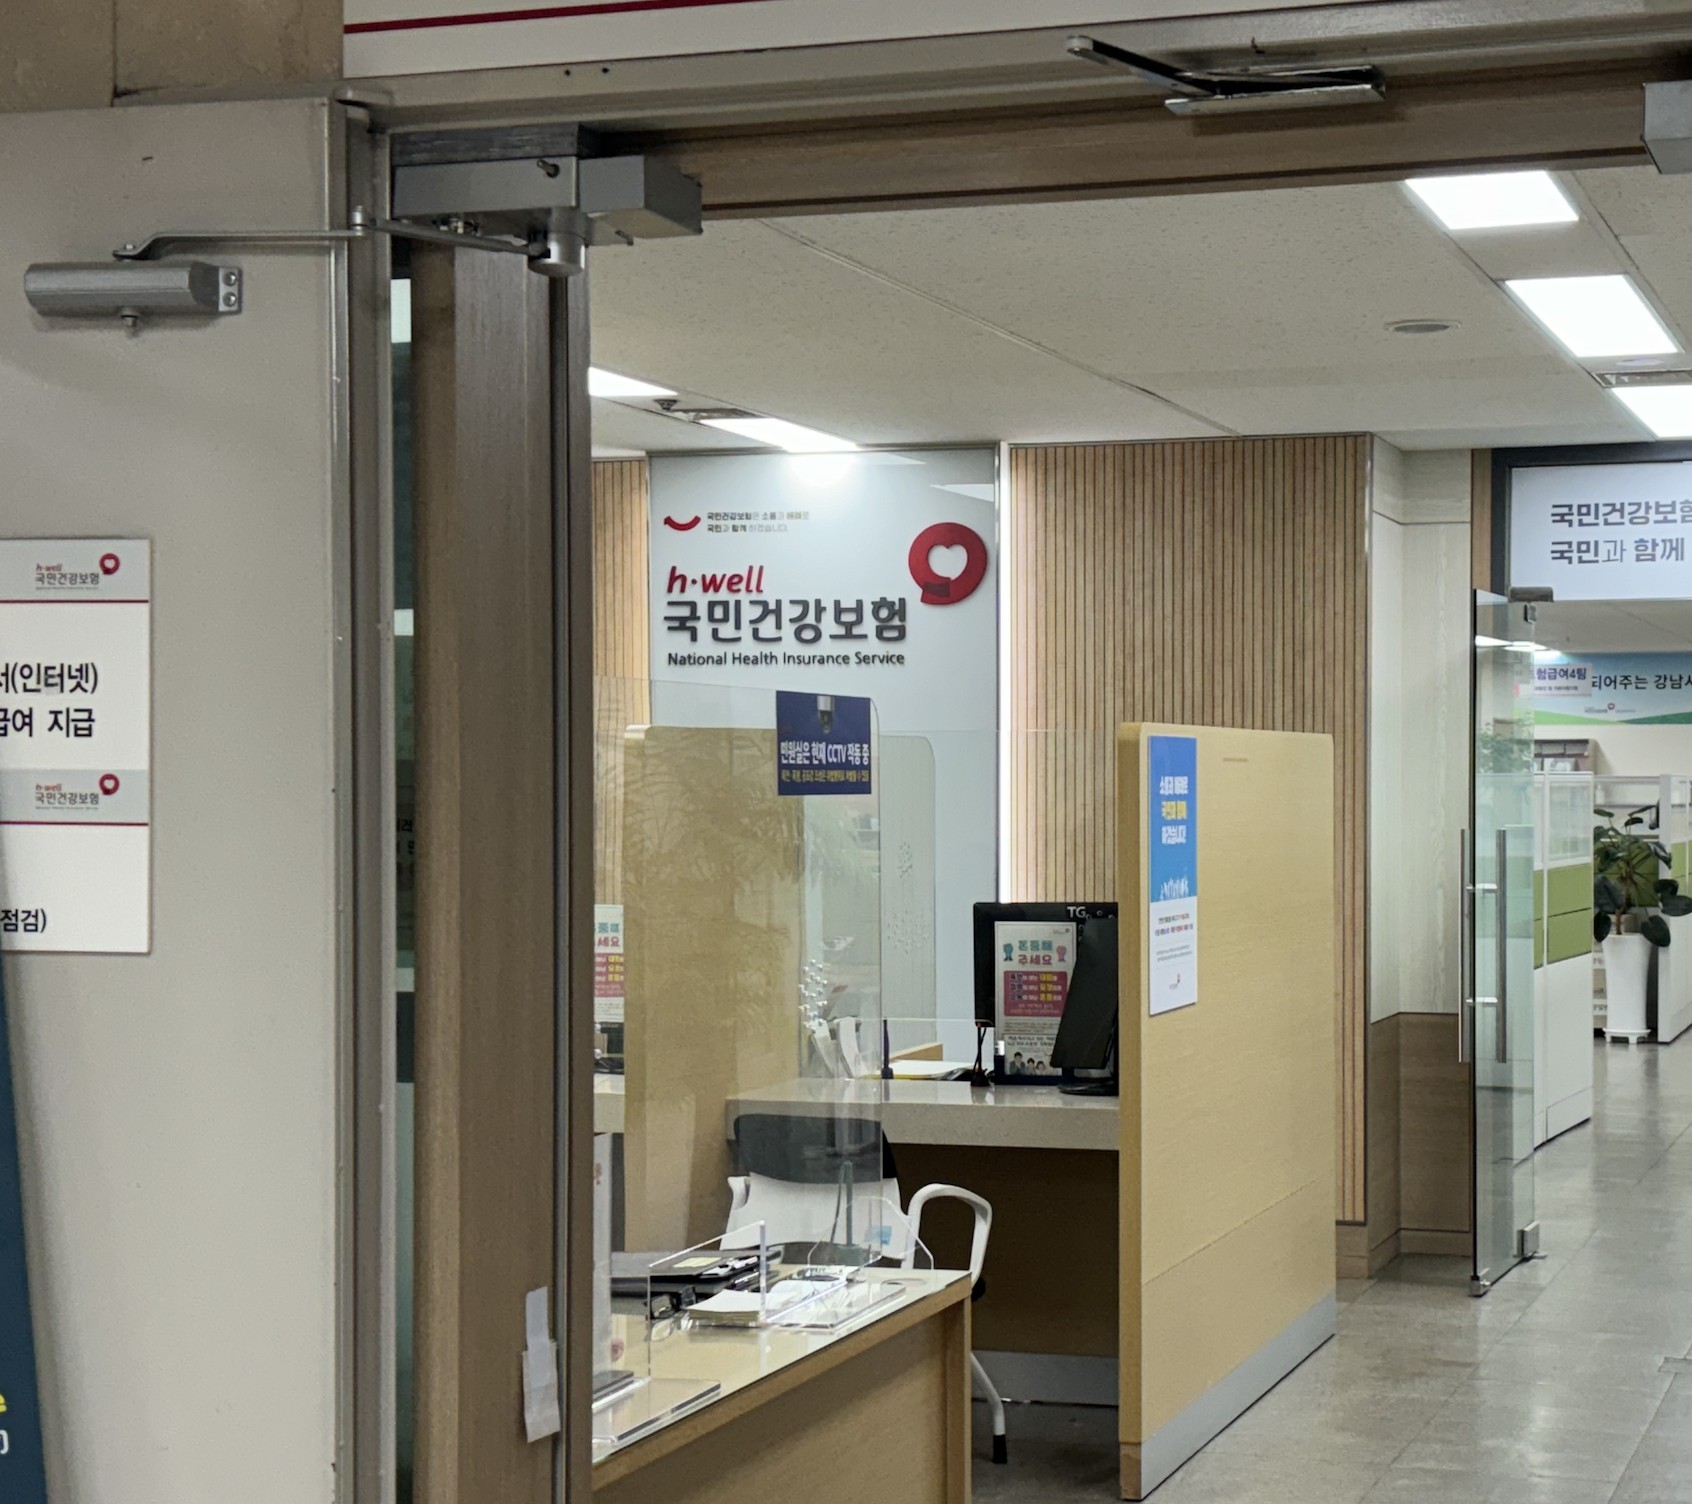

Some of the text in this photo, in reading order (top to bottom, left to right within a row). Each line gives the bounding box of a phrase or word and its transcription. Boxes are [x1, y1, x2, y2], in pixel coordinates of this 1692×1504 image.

[1551, 537, 1685, 565] 국민과 함께
[35, 572, 100, 586] 국민건강보험
[663, 597, 907, 644] 국민건강보험
[667, 651, 905, 666] National Health Insurance Service
[48, 707, 96, 738] 지급
[780, 740, 811, 765] 민원실은
[811, 741, 826, 765] 현재
[827, 743, 847, 763] CCTV
[35, 792, 99, 805] 국민건강보험
[1066, 905, 1087, 918] TG
[1018, 954, 1052, 966] 주세요
